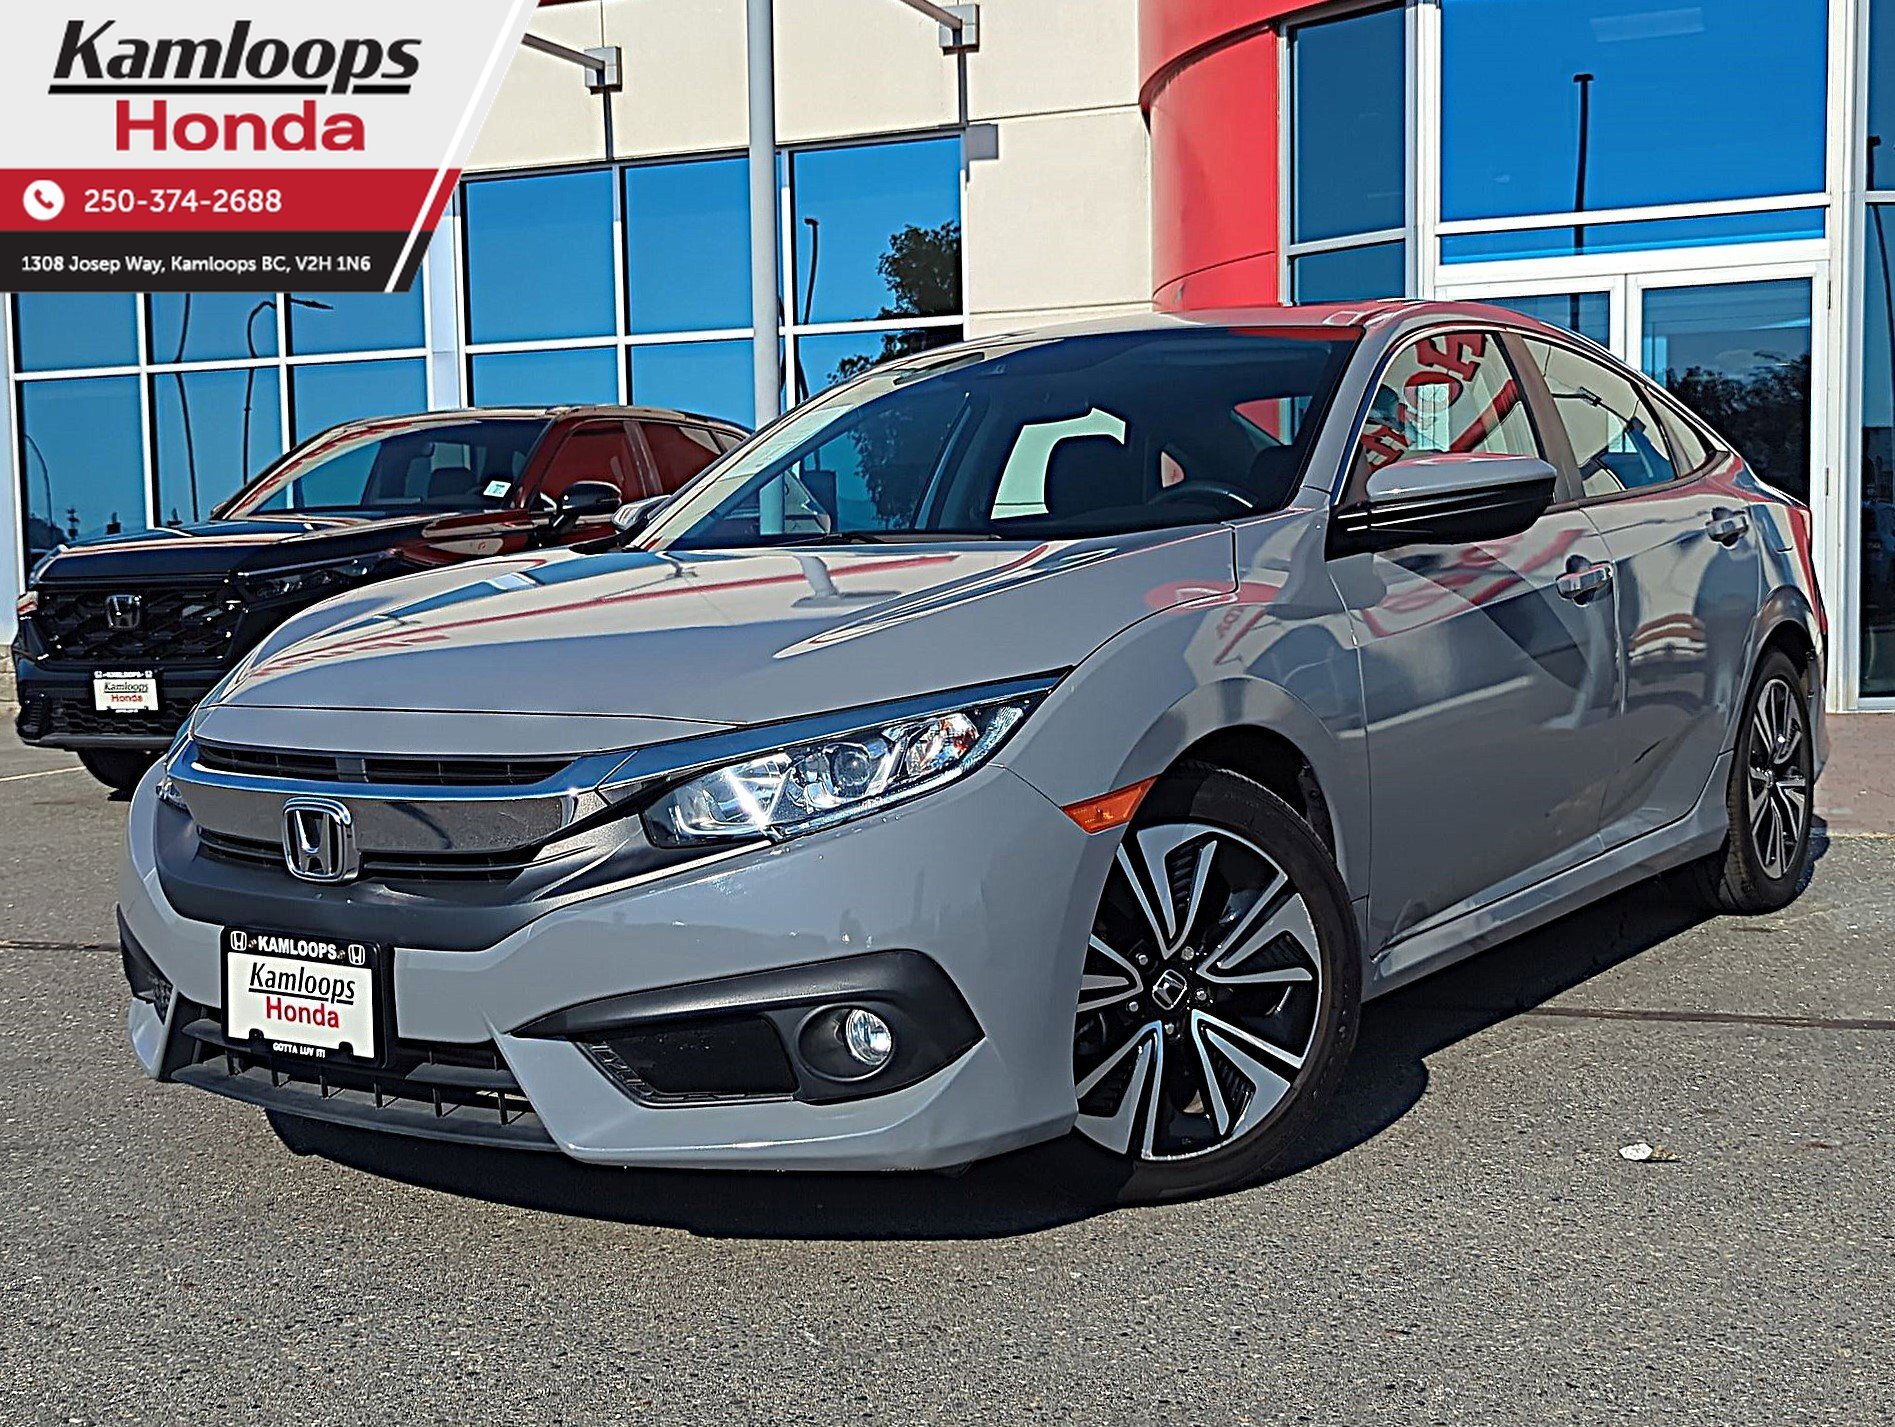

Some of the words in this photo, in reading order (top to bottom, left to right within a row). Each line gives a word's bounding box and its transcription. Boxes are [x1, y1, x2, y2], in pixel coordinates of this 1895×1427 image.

[111, 694, 143, 703] Honda
[258, 935, 337, 960] KAMLOOPS
[250, 961, 356, 1004] Kamloops
[266, 996, 340, 1028] Honda
[272, 1042, 299, 1055] GOTTA
[300, 1045, 314, 1056] LUV
